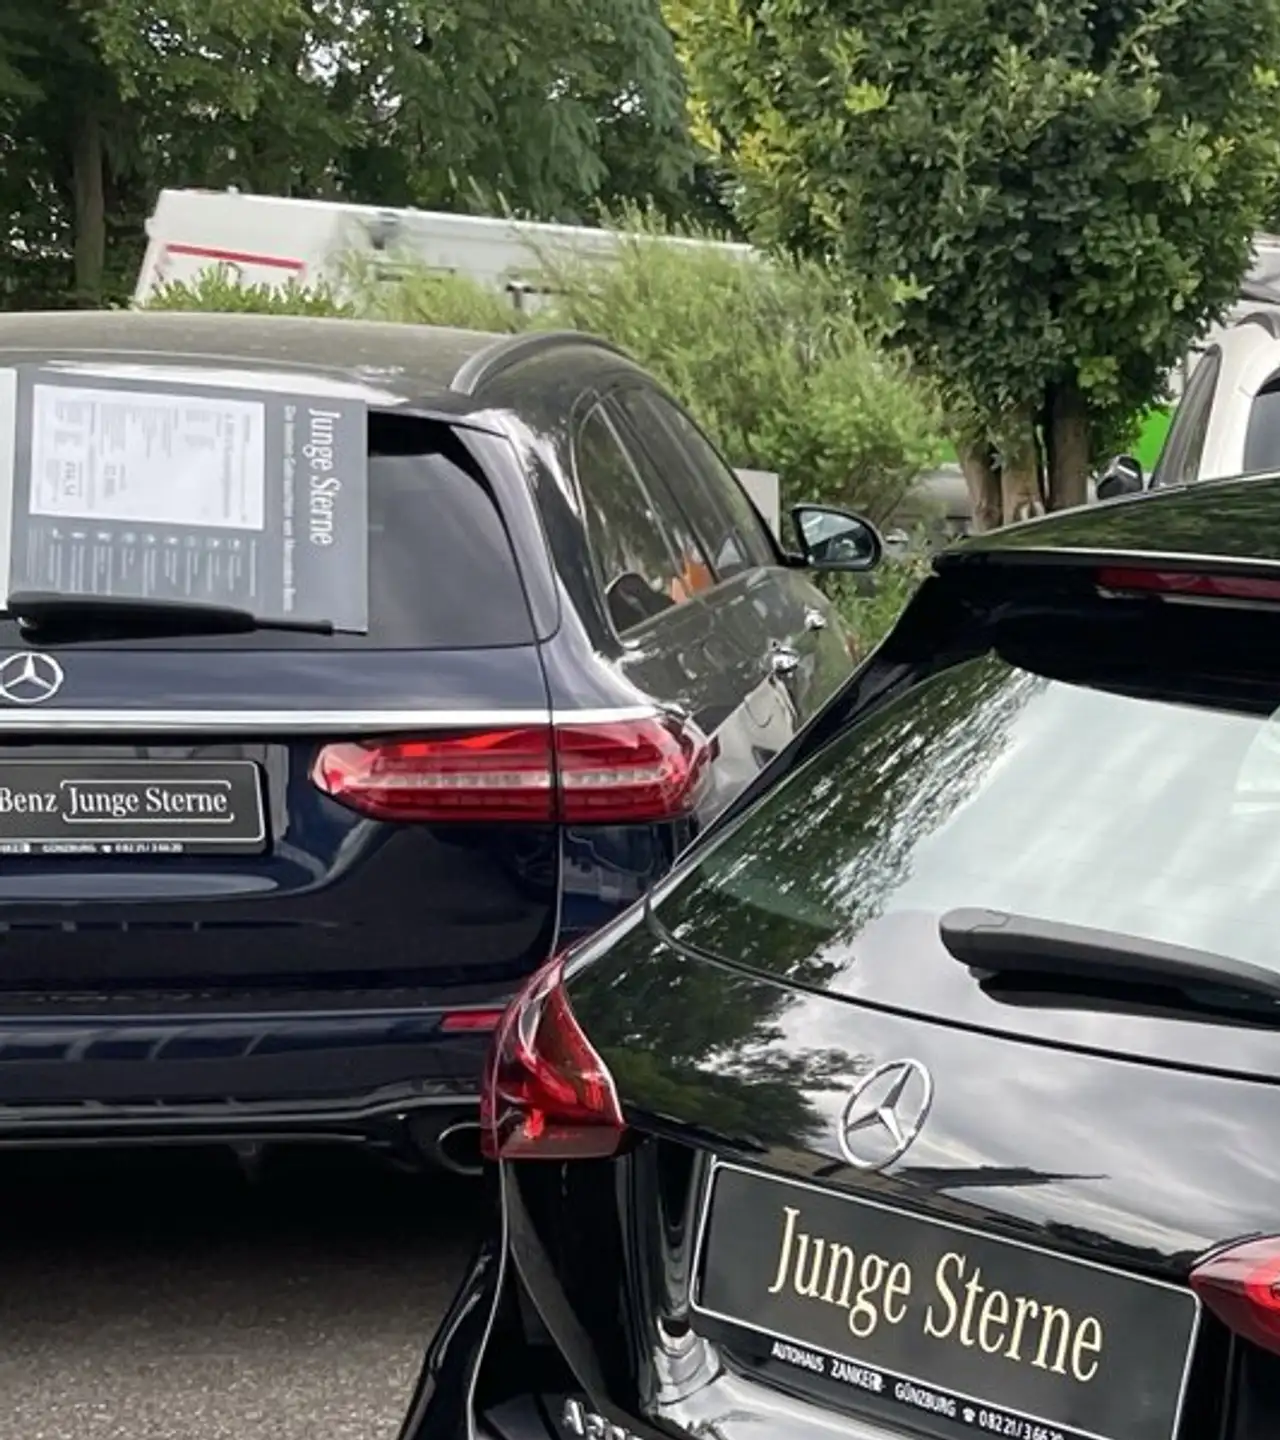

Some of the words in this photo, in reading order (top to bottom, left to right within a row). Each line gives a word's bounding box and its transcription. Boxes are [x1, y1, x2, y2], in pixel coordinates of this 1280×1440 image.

[302, 408, 341, 470] Junge
[309, 475, 342, 545] Sterne
[69, 787, 139, 817] Junge
[145, 786, 228, 813] Sterne
[768, 1206, 912, 1338] Junge
[923, 1252, 1102, 1382] Sterne
[771, 1341, 825, 1373] AUTOHAUS
